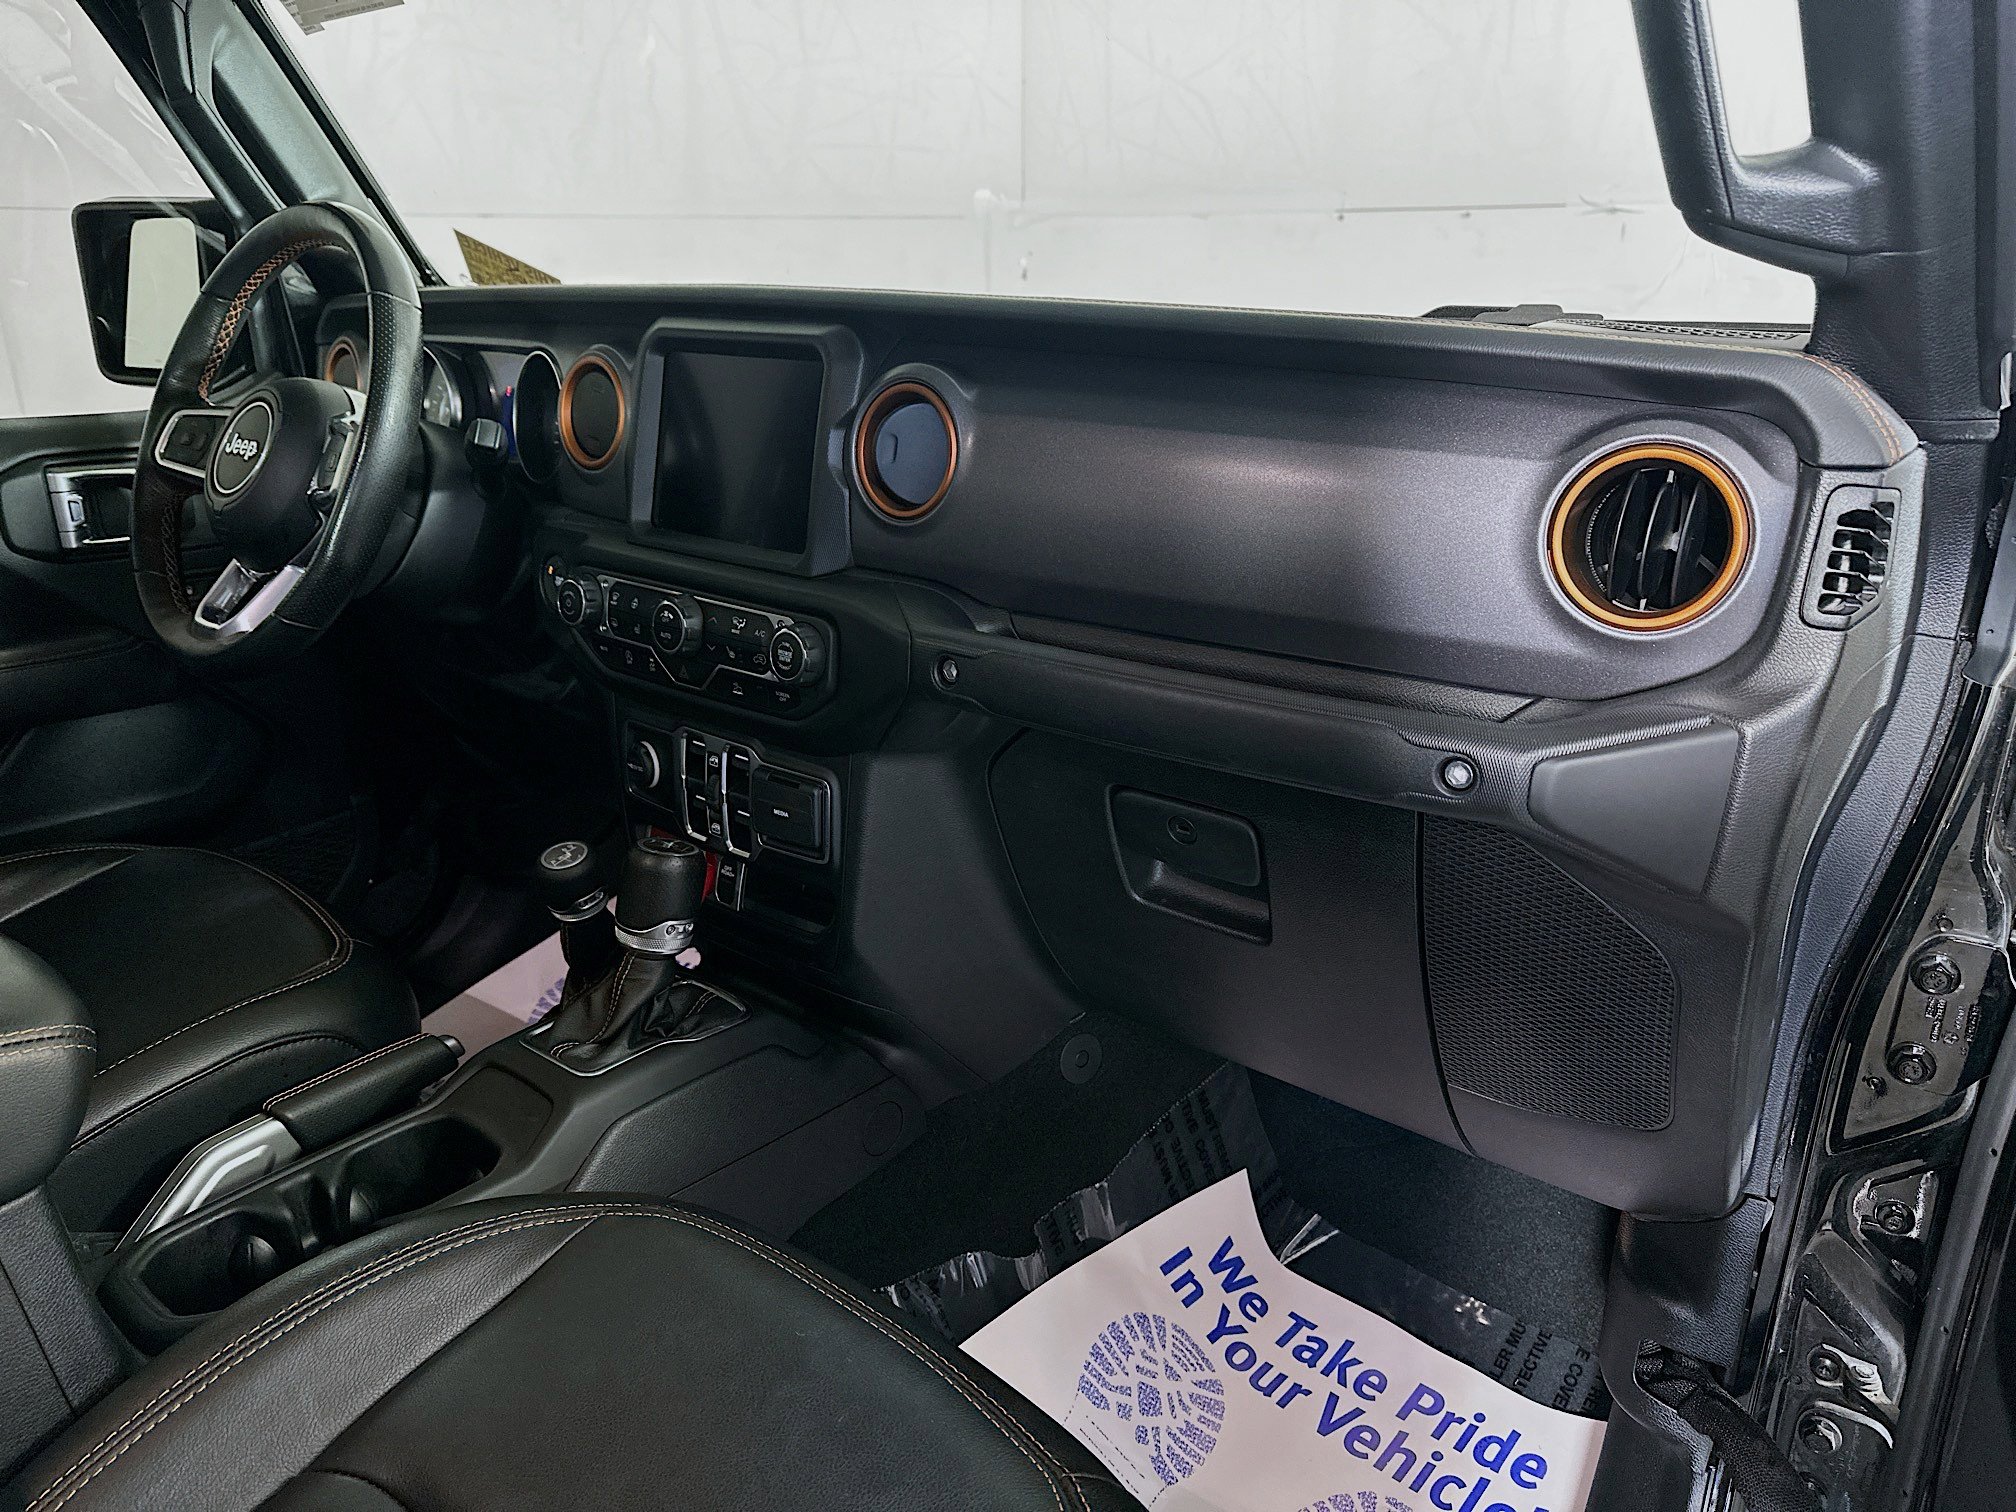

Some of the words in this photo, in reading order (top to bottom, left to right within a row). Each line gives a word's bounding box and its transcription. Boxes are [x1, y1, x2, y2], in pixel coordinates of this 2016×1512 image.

[225, 433, 258, 461] Jeep
[754, 629, 766, 638] A/C
[773, 808, 790, 818] MEDIA
[1159, 1246, 1204, 1309] In
[1206, 1302, 1313, 1410] Your
[1316, 1391, 1550, 1512] Vehicl
[1208, 1235, 1269, 1323] We
[1275, 1311, 1388, 1402] Take
[1395, 1382, 1548, 1490] Pride
[1512, 1329, 1553, 1389] TECTIVE
